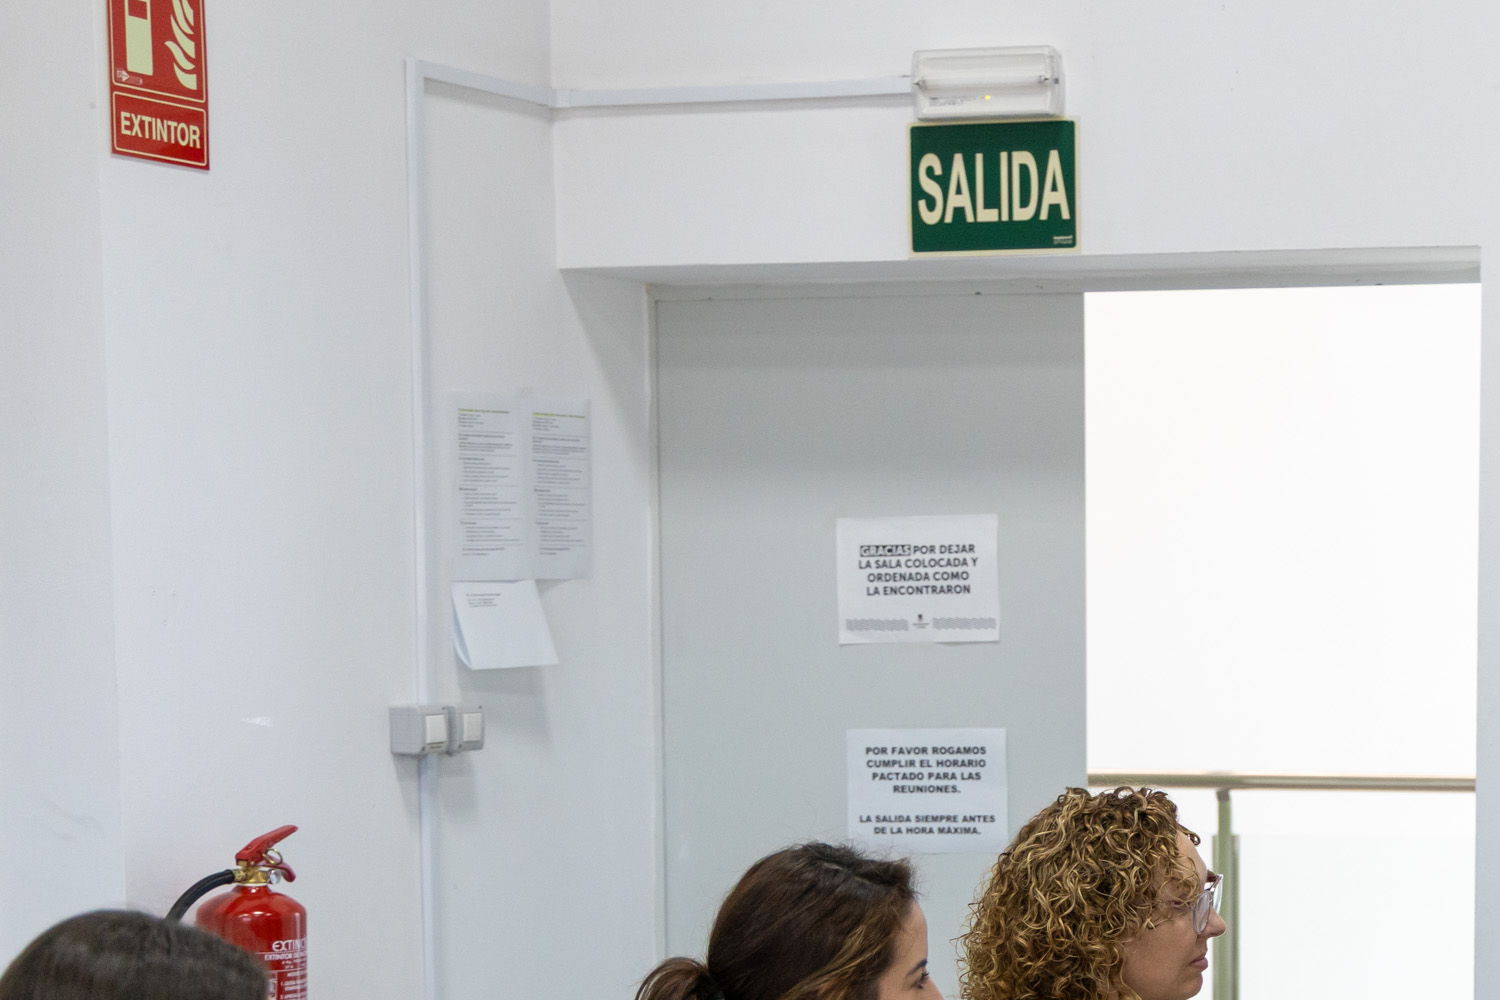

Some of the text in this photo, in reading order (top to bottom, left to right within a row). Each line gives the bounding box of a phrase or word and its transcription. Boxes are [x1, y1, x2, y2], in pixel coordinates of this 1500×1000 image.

[120, 111, 201, 149] EXTINTOR
[917, 150, 1071, 226] SALIDA
[860, 544, 975, 557] GRACIAS POR DEJAR
[858, 557, 978, 569] LA SALA COLOCADA Y
[867, 571, 969, 583] ORDENADA COMO
[867, 585, 971, 596] LA ENCONTRARON
[865, 746, 987, 755] POR FAVOR ROGAMOS
[866, 759, 986, 768] CUMPLIR EL HORARIO
[872, 772, 981, 781] PACTADO PARA LAS
[893, 785, 961, 793] REUNIONES.
[859, 815, 996, 823] LA SALIDA SIEMPRE ANTES
[874, 826, 887, 835] DE
[890, 826, 903, 835] LA
[906, 826, 934, 835] HORA
